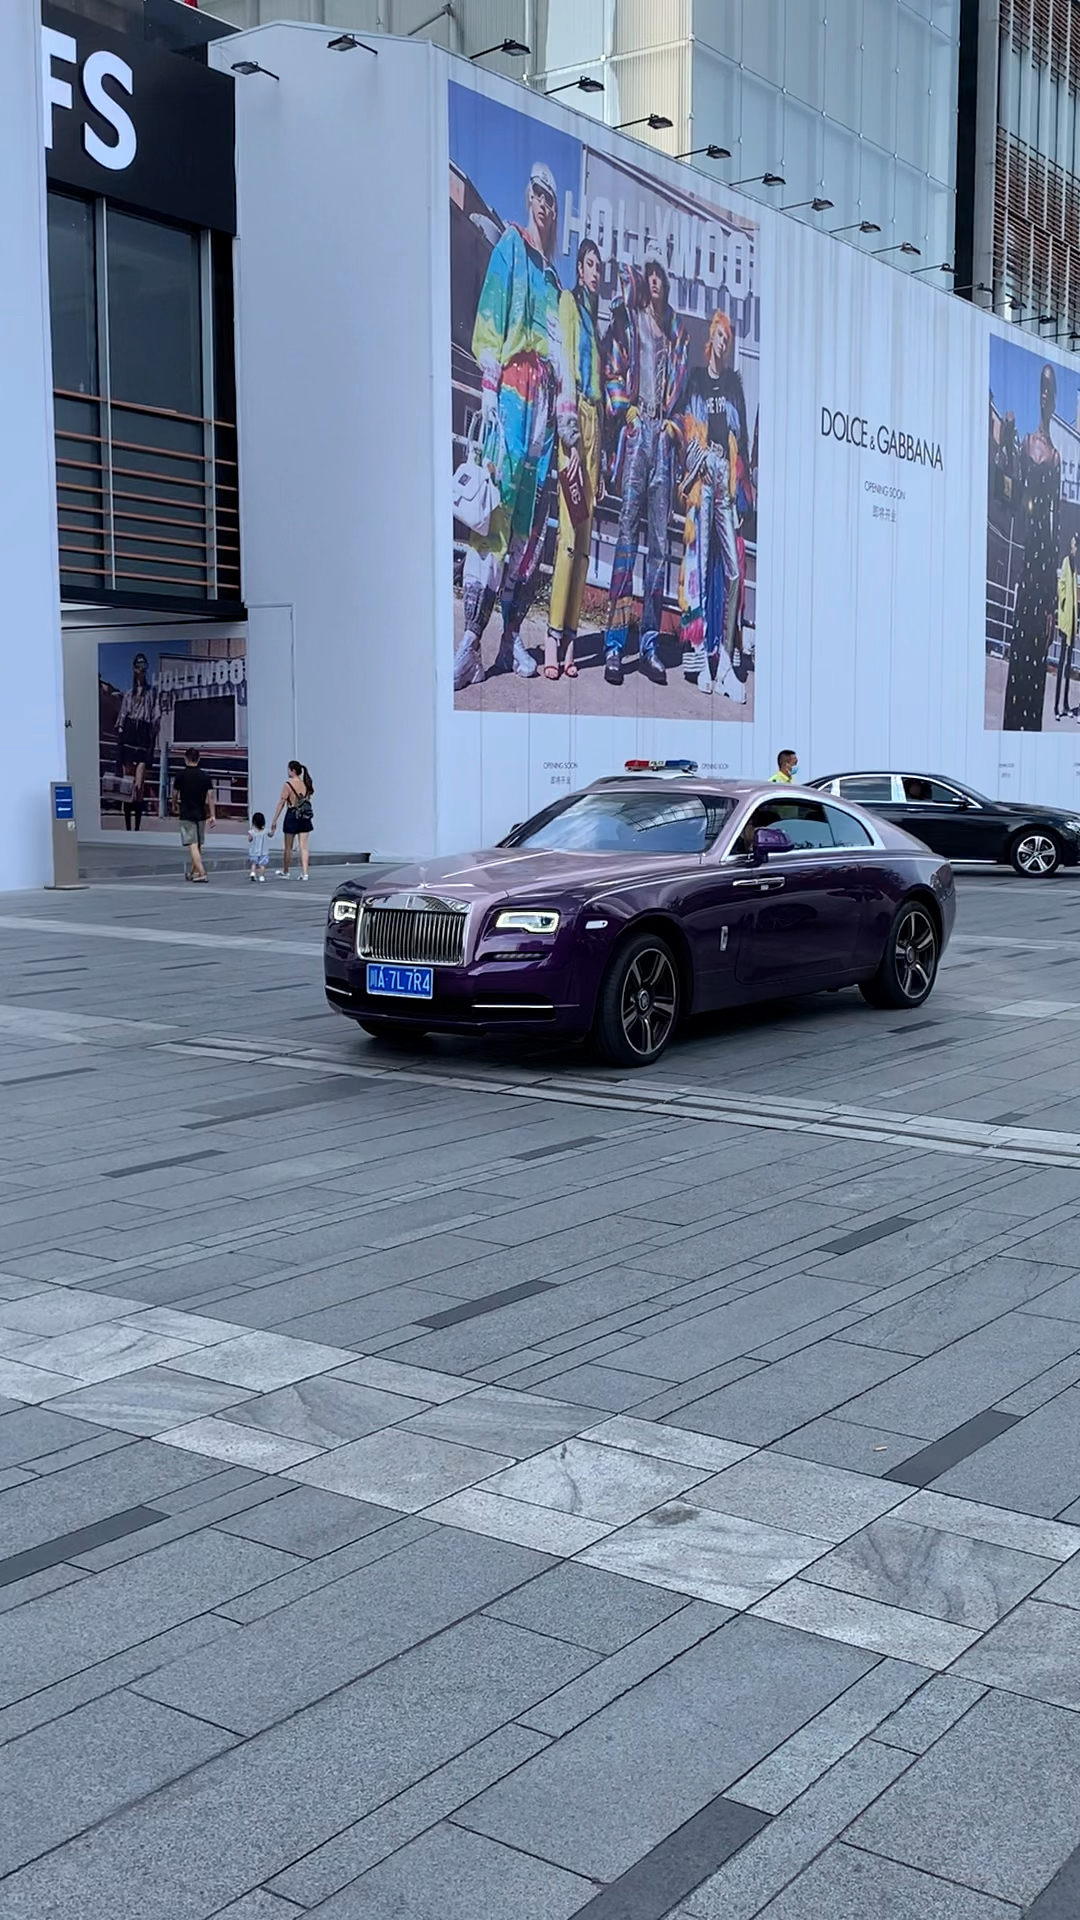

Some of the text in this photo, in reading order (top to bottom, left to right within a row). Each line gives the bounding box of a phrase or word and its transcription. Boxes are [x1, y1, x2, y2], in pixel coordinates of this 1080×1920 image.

[821, 406, 943, 471] DOLCE & GABBANA
[864, 480, 905, 500] OPENING SOON
